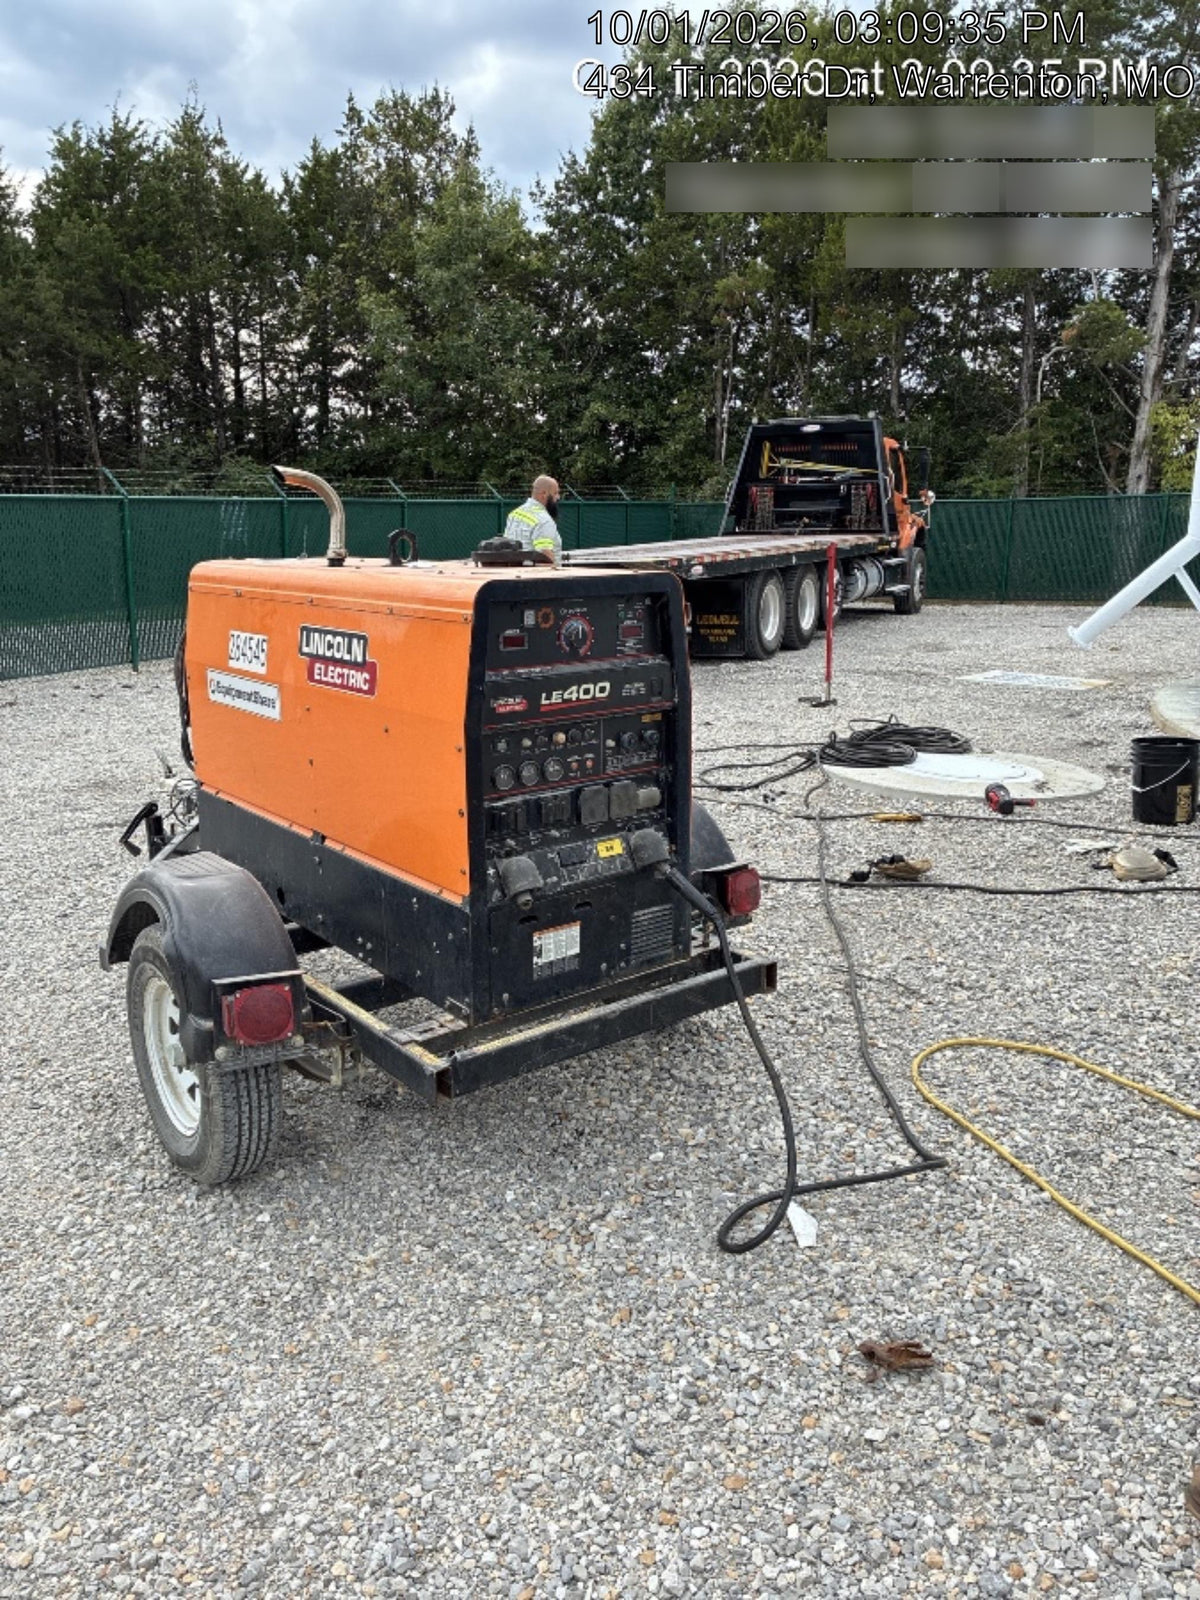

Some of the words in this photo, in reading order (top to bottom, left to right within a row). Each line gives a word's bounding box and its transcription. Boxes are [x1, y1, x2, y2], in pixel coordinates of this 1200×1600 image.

[301, 630, 364, 663] LINCOLN
[313, 662, 370, 690] ELECTRIC
[540, 681, 611, 704] LE400
